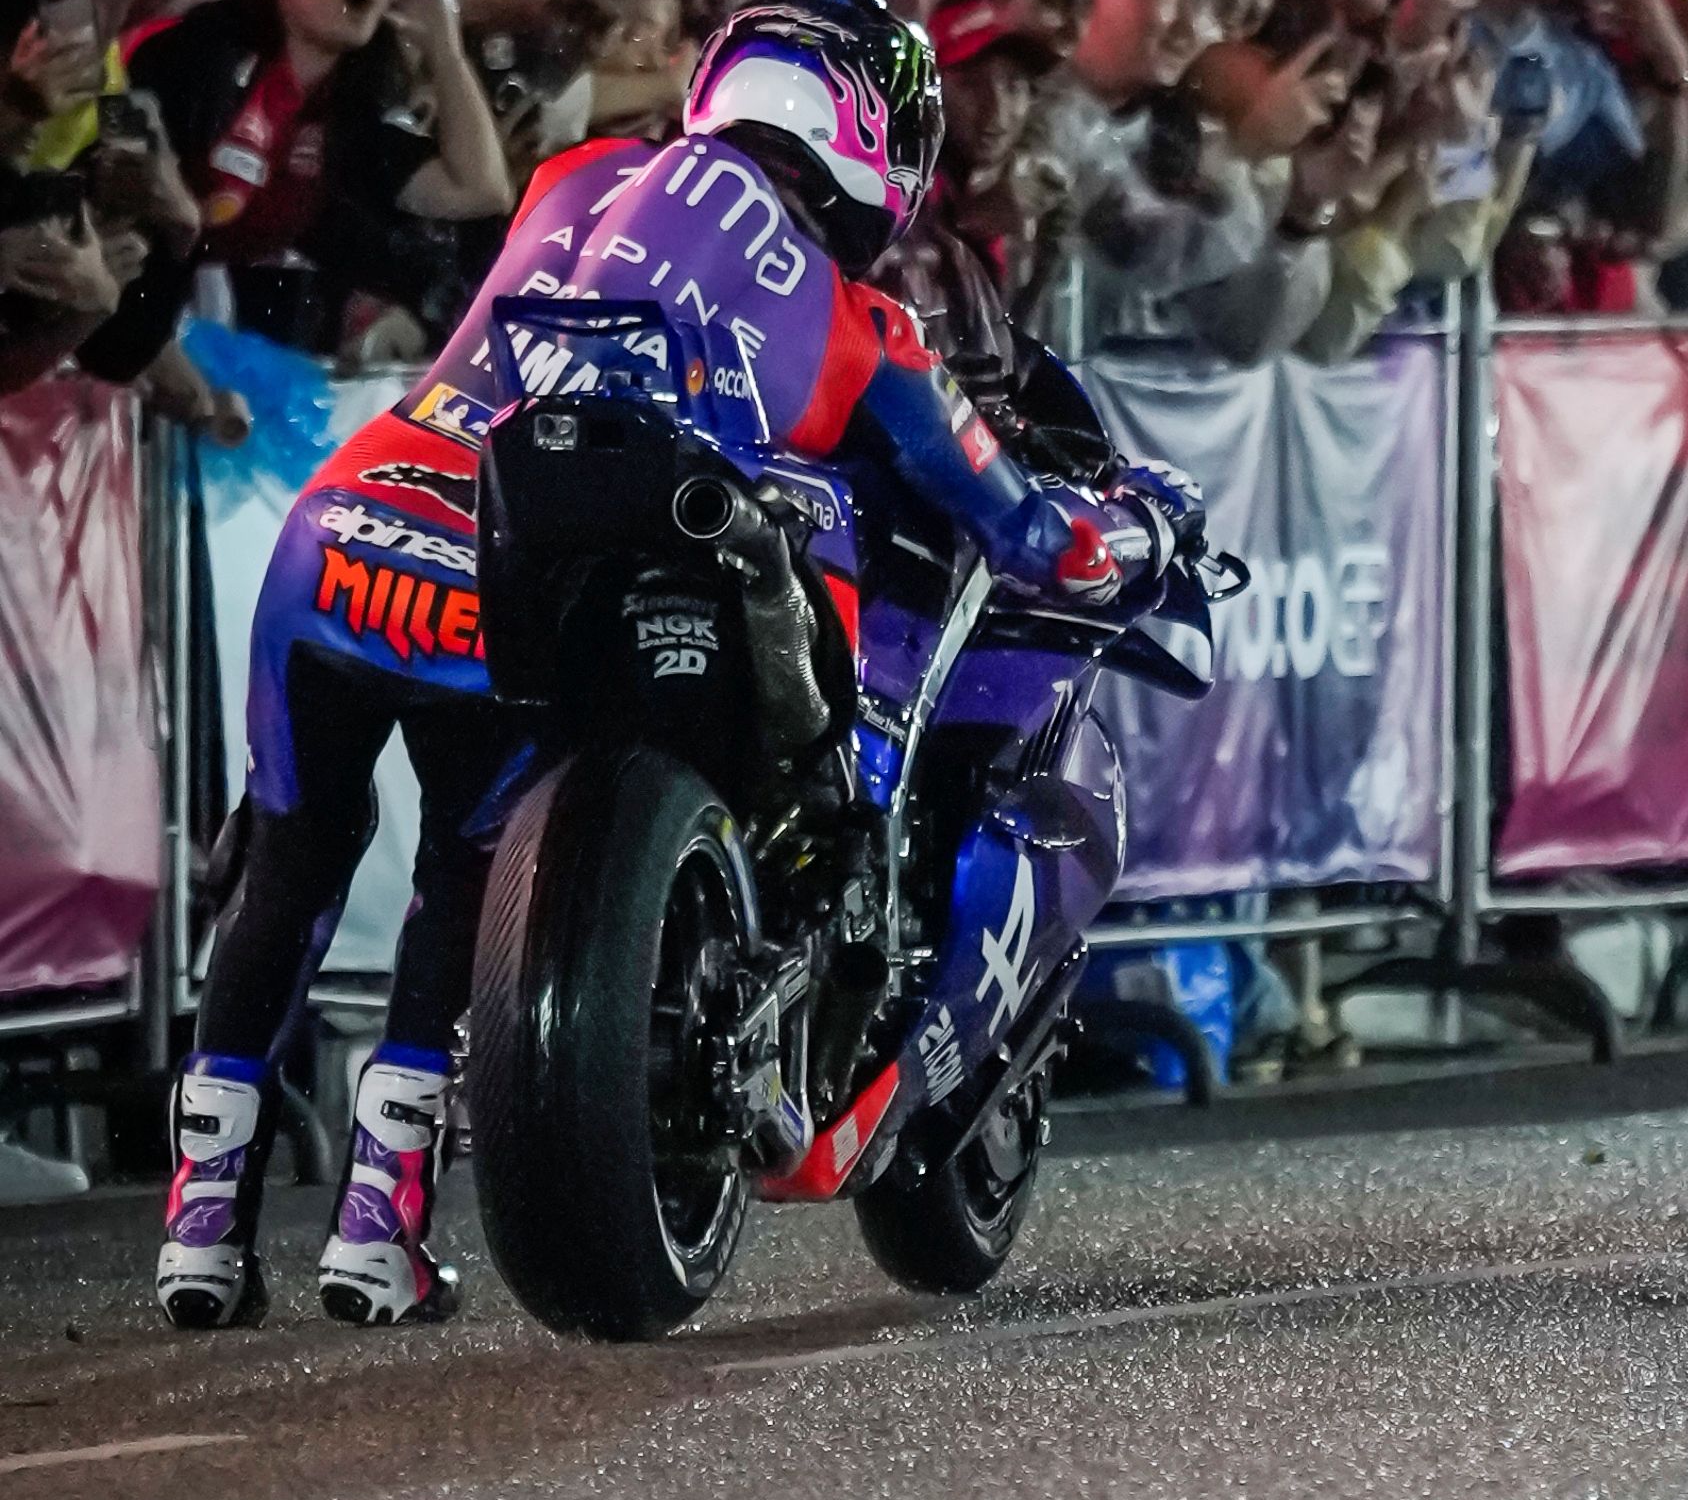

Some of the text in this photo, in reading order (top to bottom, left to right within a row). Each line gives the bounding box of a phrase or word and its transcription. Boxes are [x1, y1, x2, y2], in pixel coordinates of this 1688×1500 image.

[316, 546, 486, 661] MILLE
[637, 614, 718, 641] NGK
[654, 649, 707, 679] 2D
